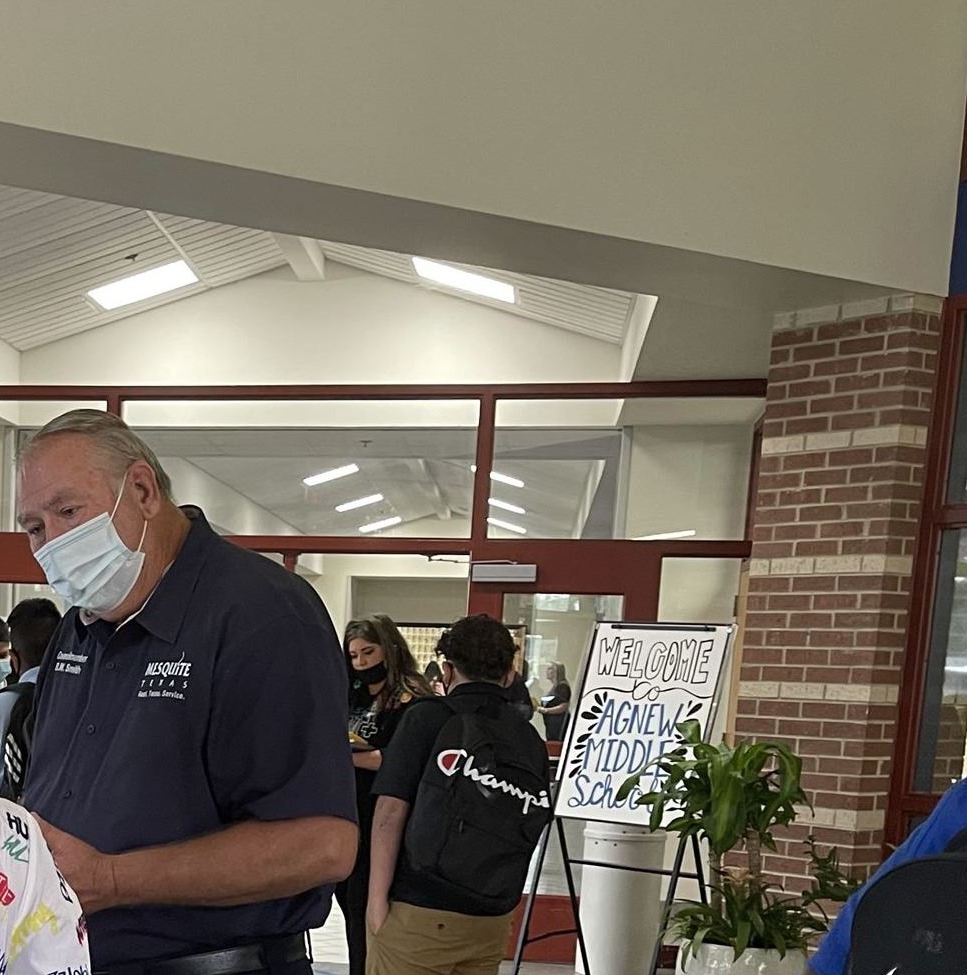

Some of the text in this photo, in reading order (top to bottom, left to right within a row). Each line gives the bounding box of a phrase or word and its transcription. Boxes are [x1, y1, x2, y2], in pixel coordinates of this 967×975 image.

[144, 660, 192, 678] MESQUITE
[598, 636, 714, 685] WELCOME
[140, 679, 188, 689] TEXAS
[595, 699, 684, 737] AGNEW
[583, 739, 674, 778] MIDDLE
